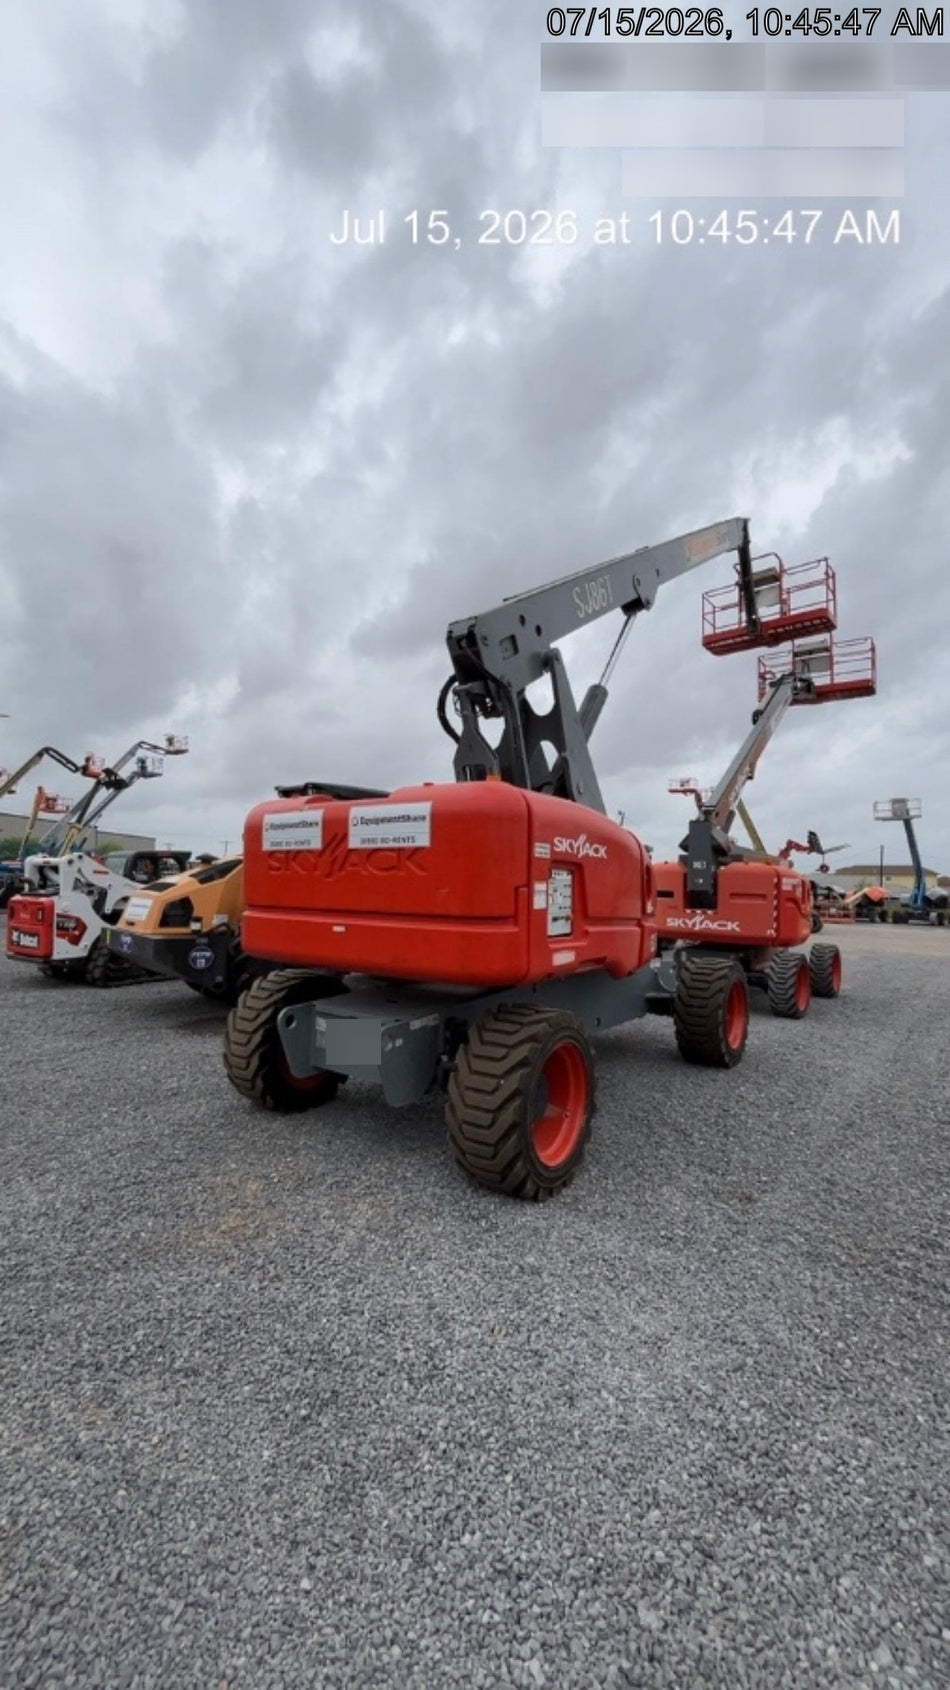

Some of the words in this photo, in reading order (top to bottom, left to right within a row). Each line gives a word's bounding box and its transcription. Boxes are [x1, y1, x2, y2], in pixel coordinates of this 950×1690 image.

[359, 813, 428, 826] EquipmentShare
[553, 833, 607, 858] SKYJACK
[267, 833, 430, 880] SKYJACK
[666, 913, 740, 931] SKYJACK
